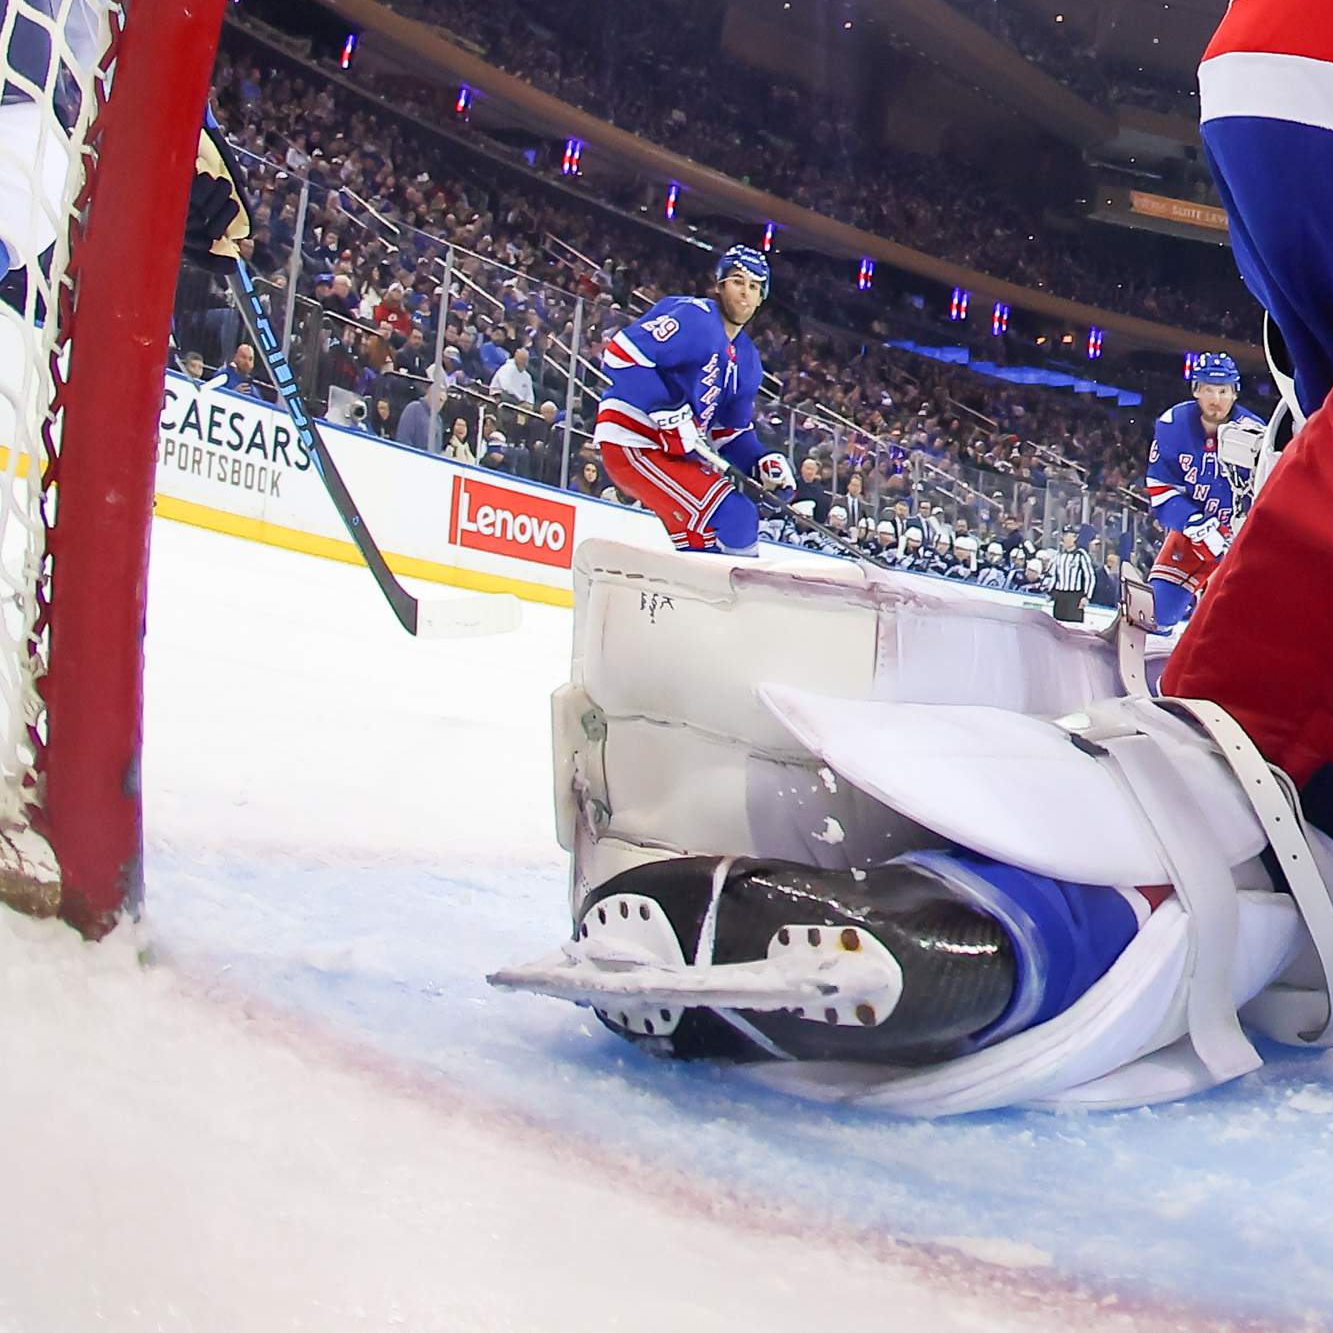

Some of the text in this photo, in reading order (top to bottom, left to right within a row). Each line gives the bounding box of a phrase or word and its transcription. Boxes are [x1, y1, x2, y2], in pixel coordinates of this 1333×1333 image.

[640, 315, 680, 342] 29
[160, 388, 312, 472] CAESARS
[657, 409, 694, 428] CCM
[157, 436, 283, 498] PORTSBOOK
[460, 492, 566, 552] Lenovo
